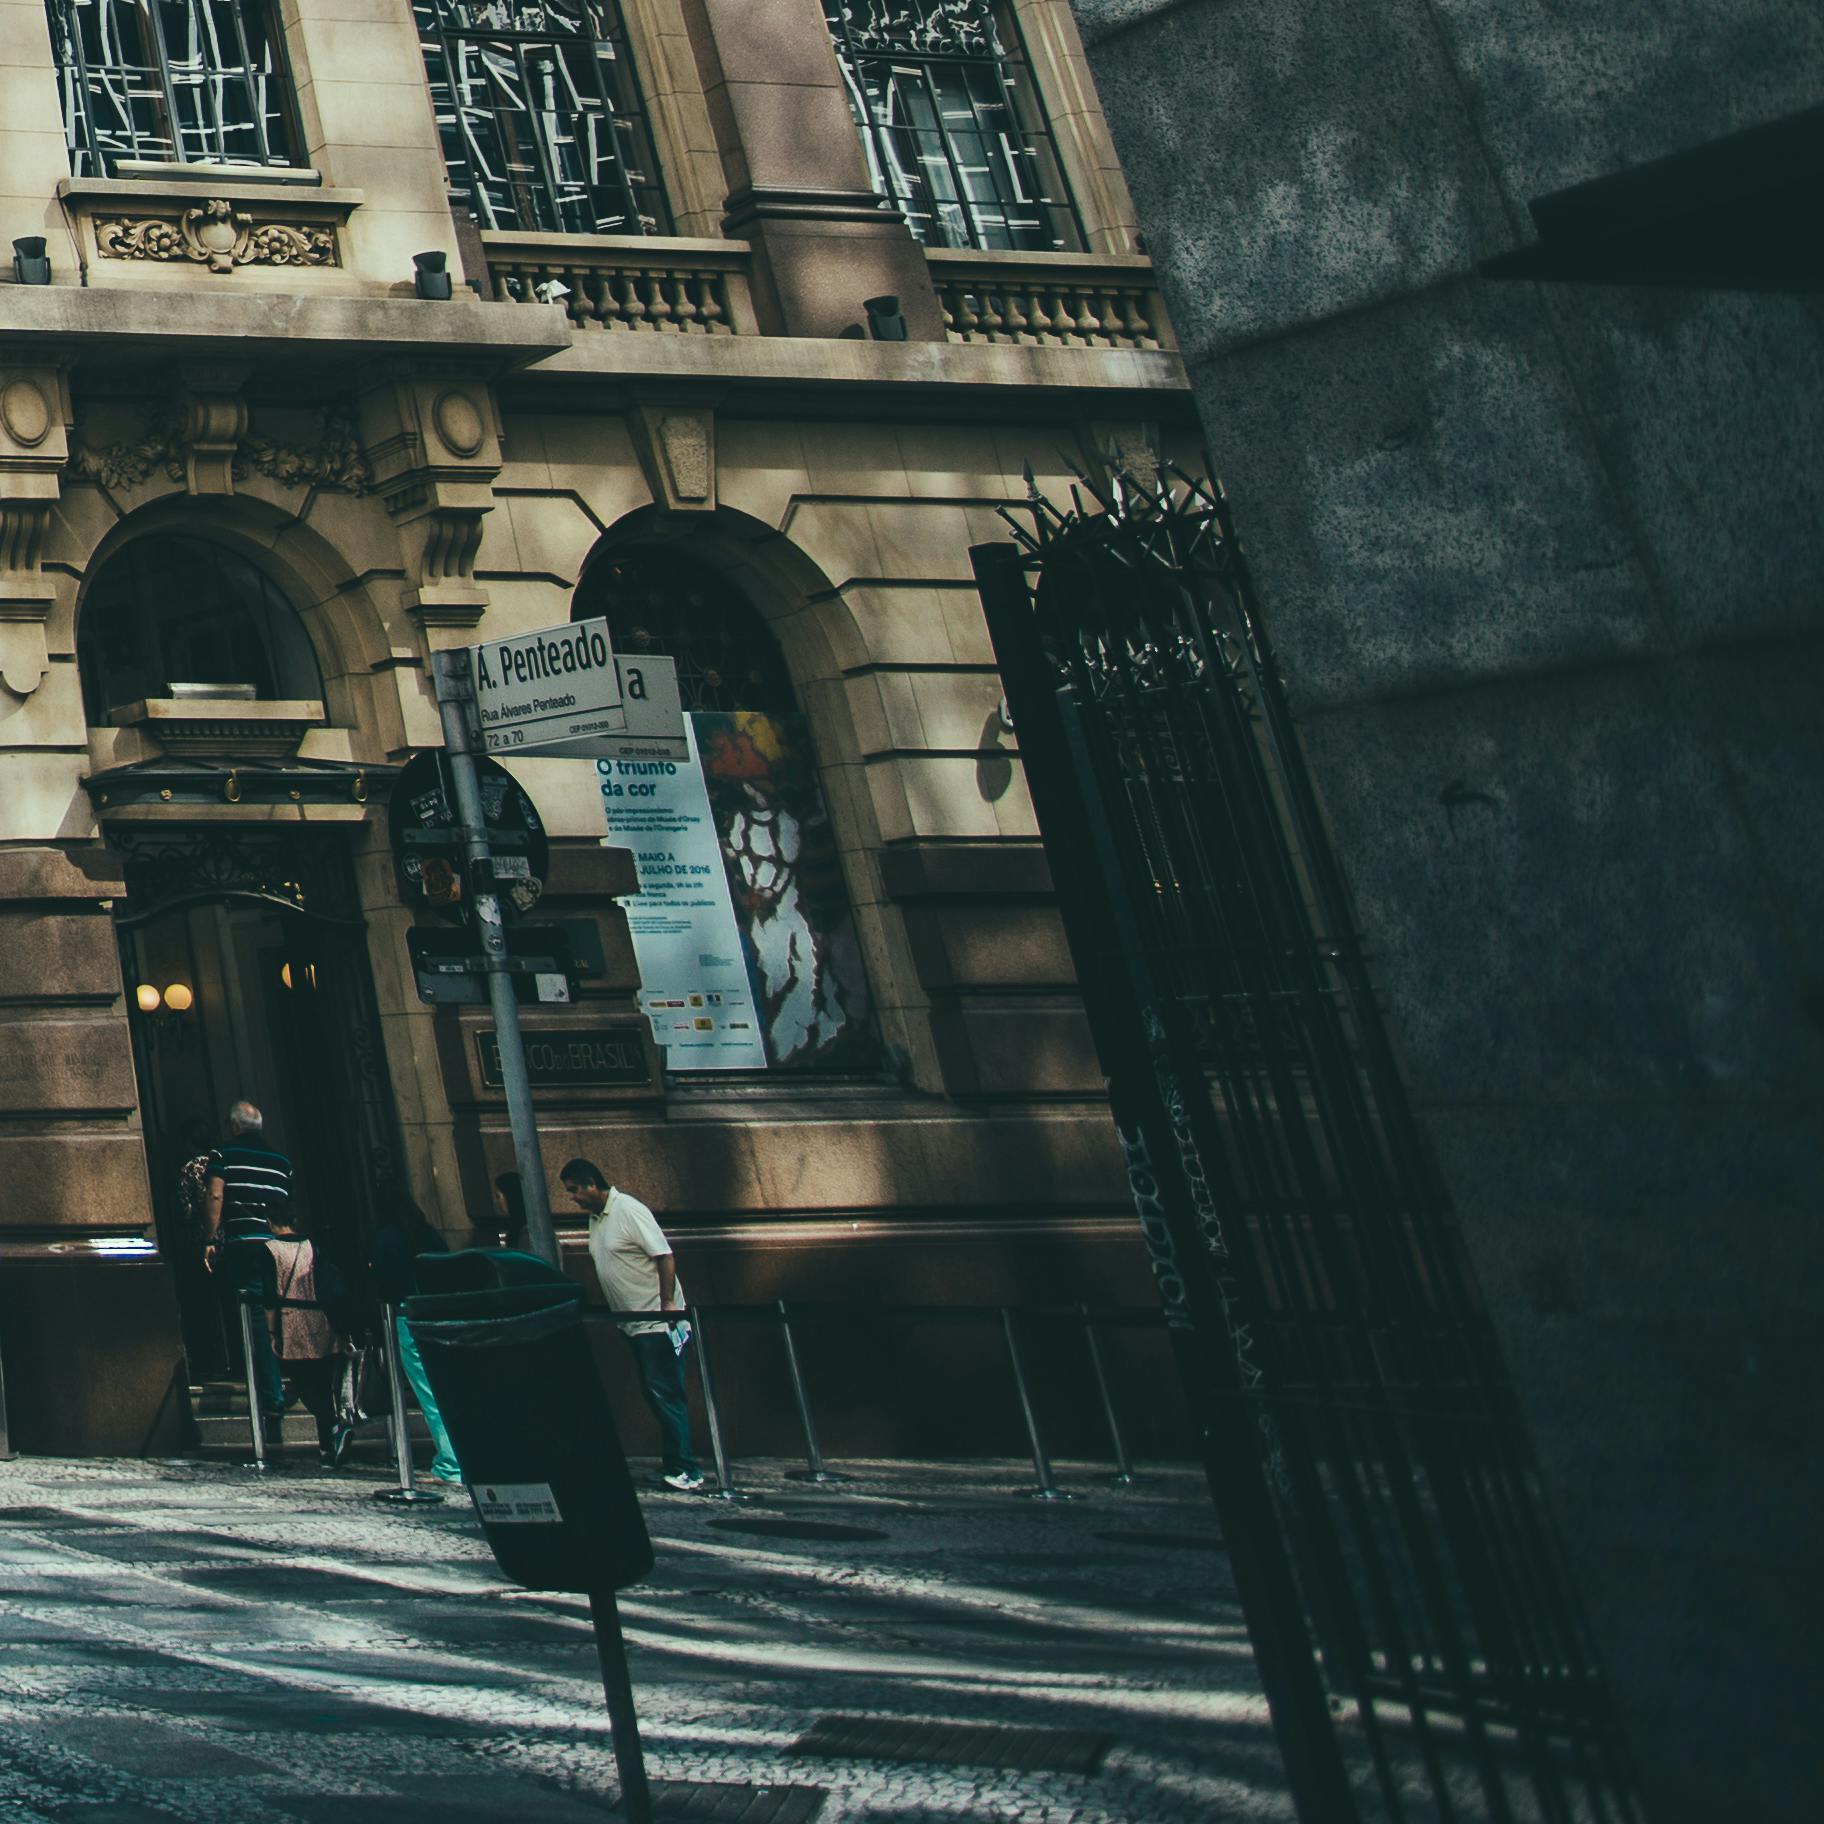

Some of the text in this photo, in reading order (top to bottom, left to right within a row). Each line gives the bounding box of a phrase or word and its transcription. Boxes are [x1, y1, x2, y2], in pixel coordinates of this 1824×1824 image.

[478, 625, 607, 691] Á. Penteado
[481, 693, 576, 722] Rua Álvares Penteado
[488, 729, 524, 747] 72 a 70
[597, 758, 677, 776] O triunfo
[601, 778, 657, 797] da cor
[640, 864, 711, 874] JULHO DE 2016
[568, 1043, 636, 1070] BRASIL
